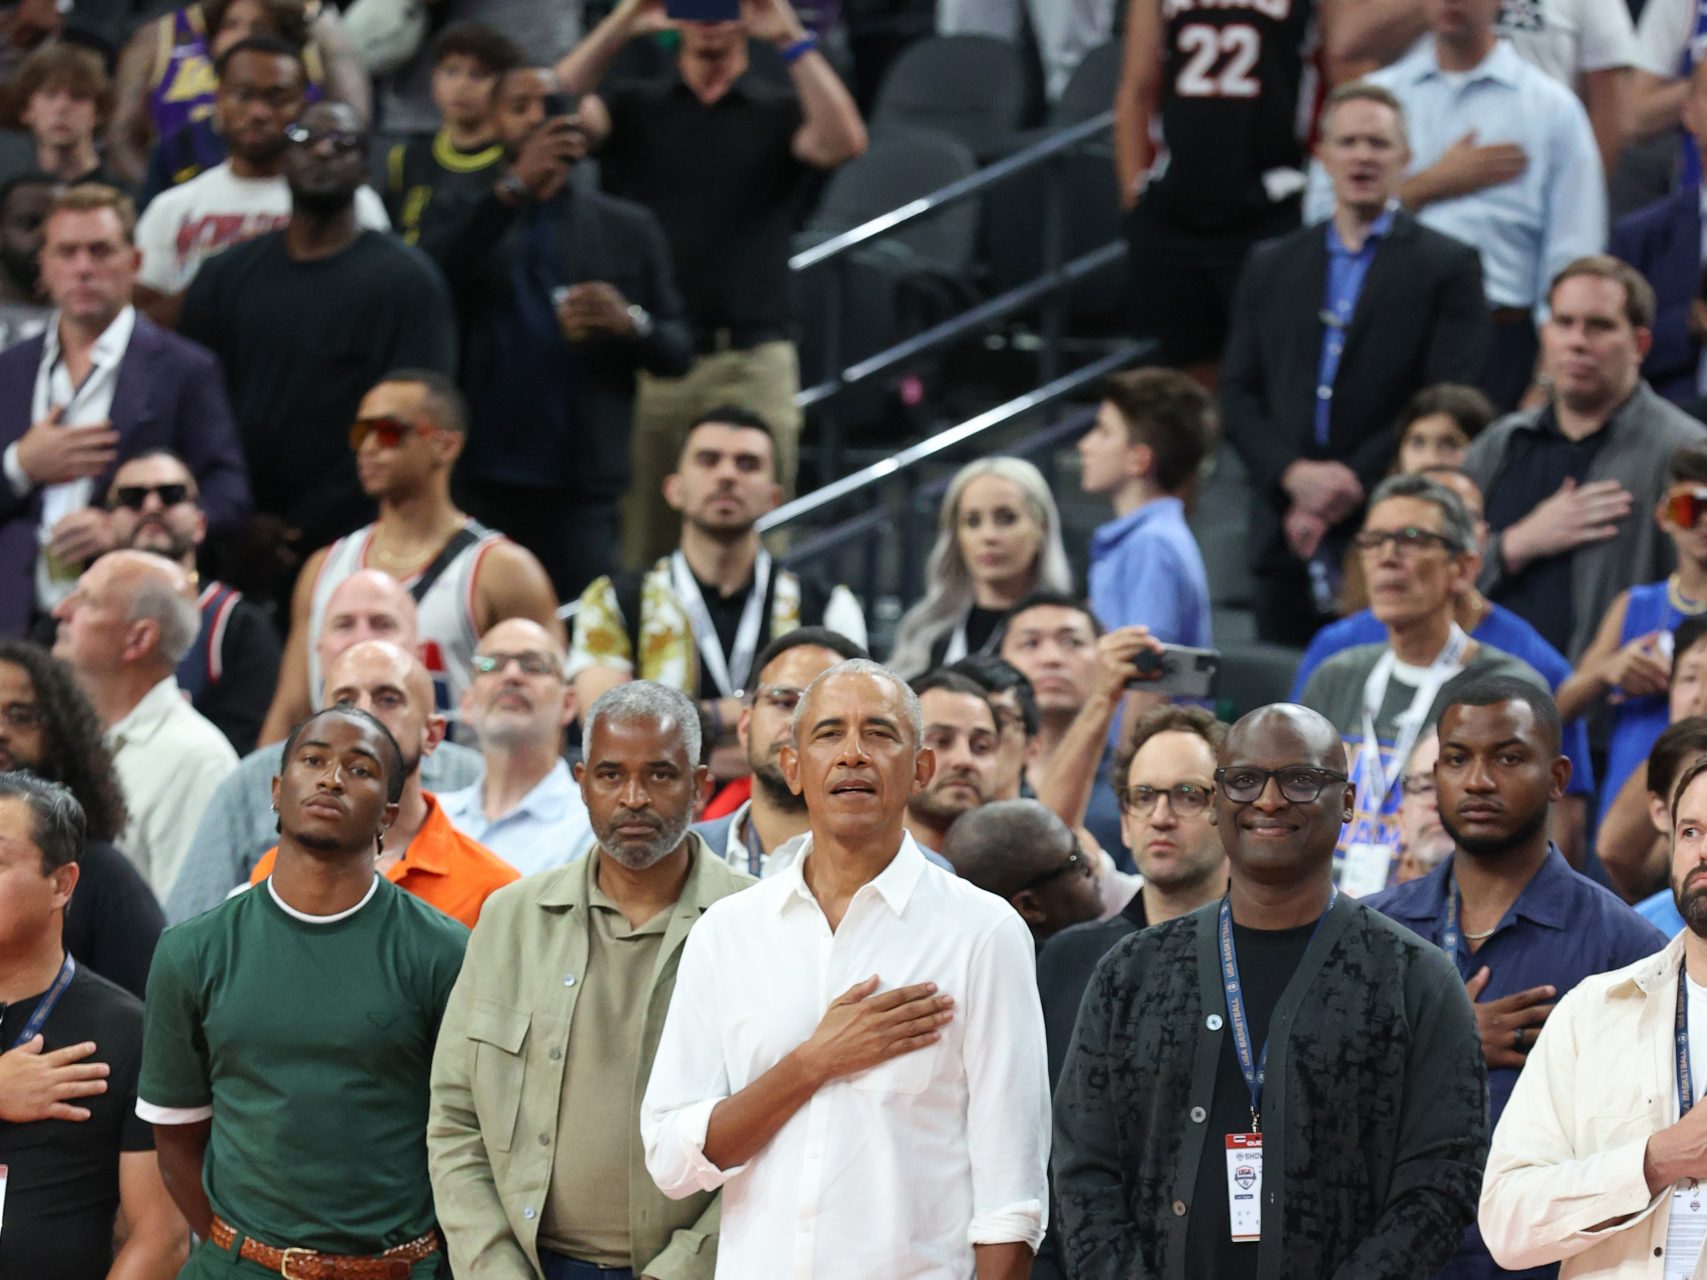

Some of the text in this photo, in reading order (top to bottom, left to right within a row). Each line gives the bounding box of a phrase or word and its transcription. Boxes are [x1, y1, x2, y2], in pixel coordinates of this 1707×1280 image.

[1176, 23, 1261, 97] 22
[1222, 917, 1235, 977] USA BASKETBALL
[1231, 997, 1250, 1066] USA BASKETBALL
[1680, 1048, 1690, 1102] BASKETBALL
